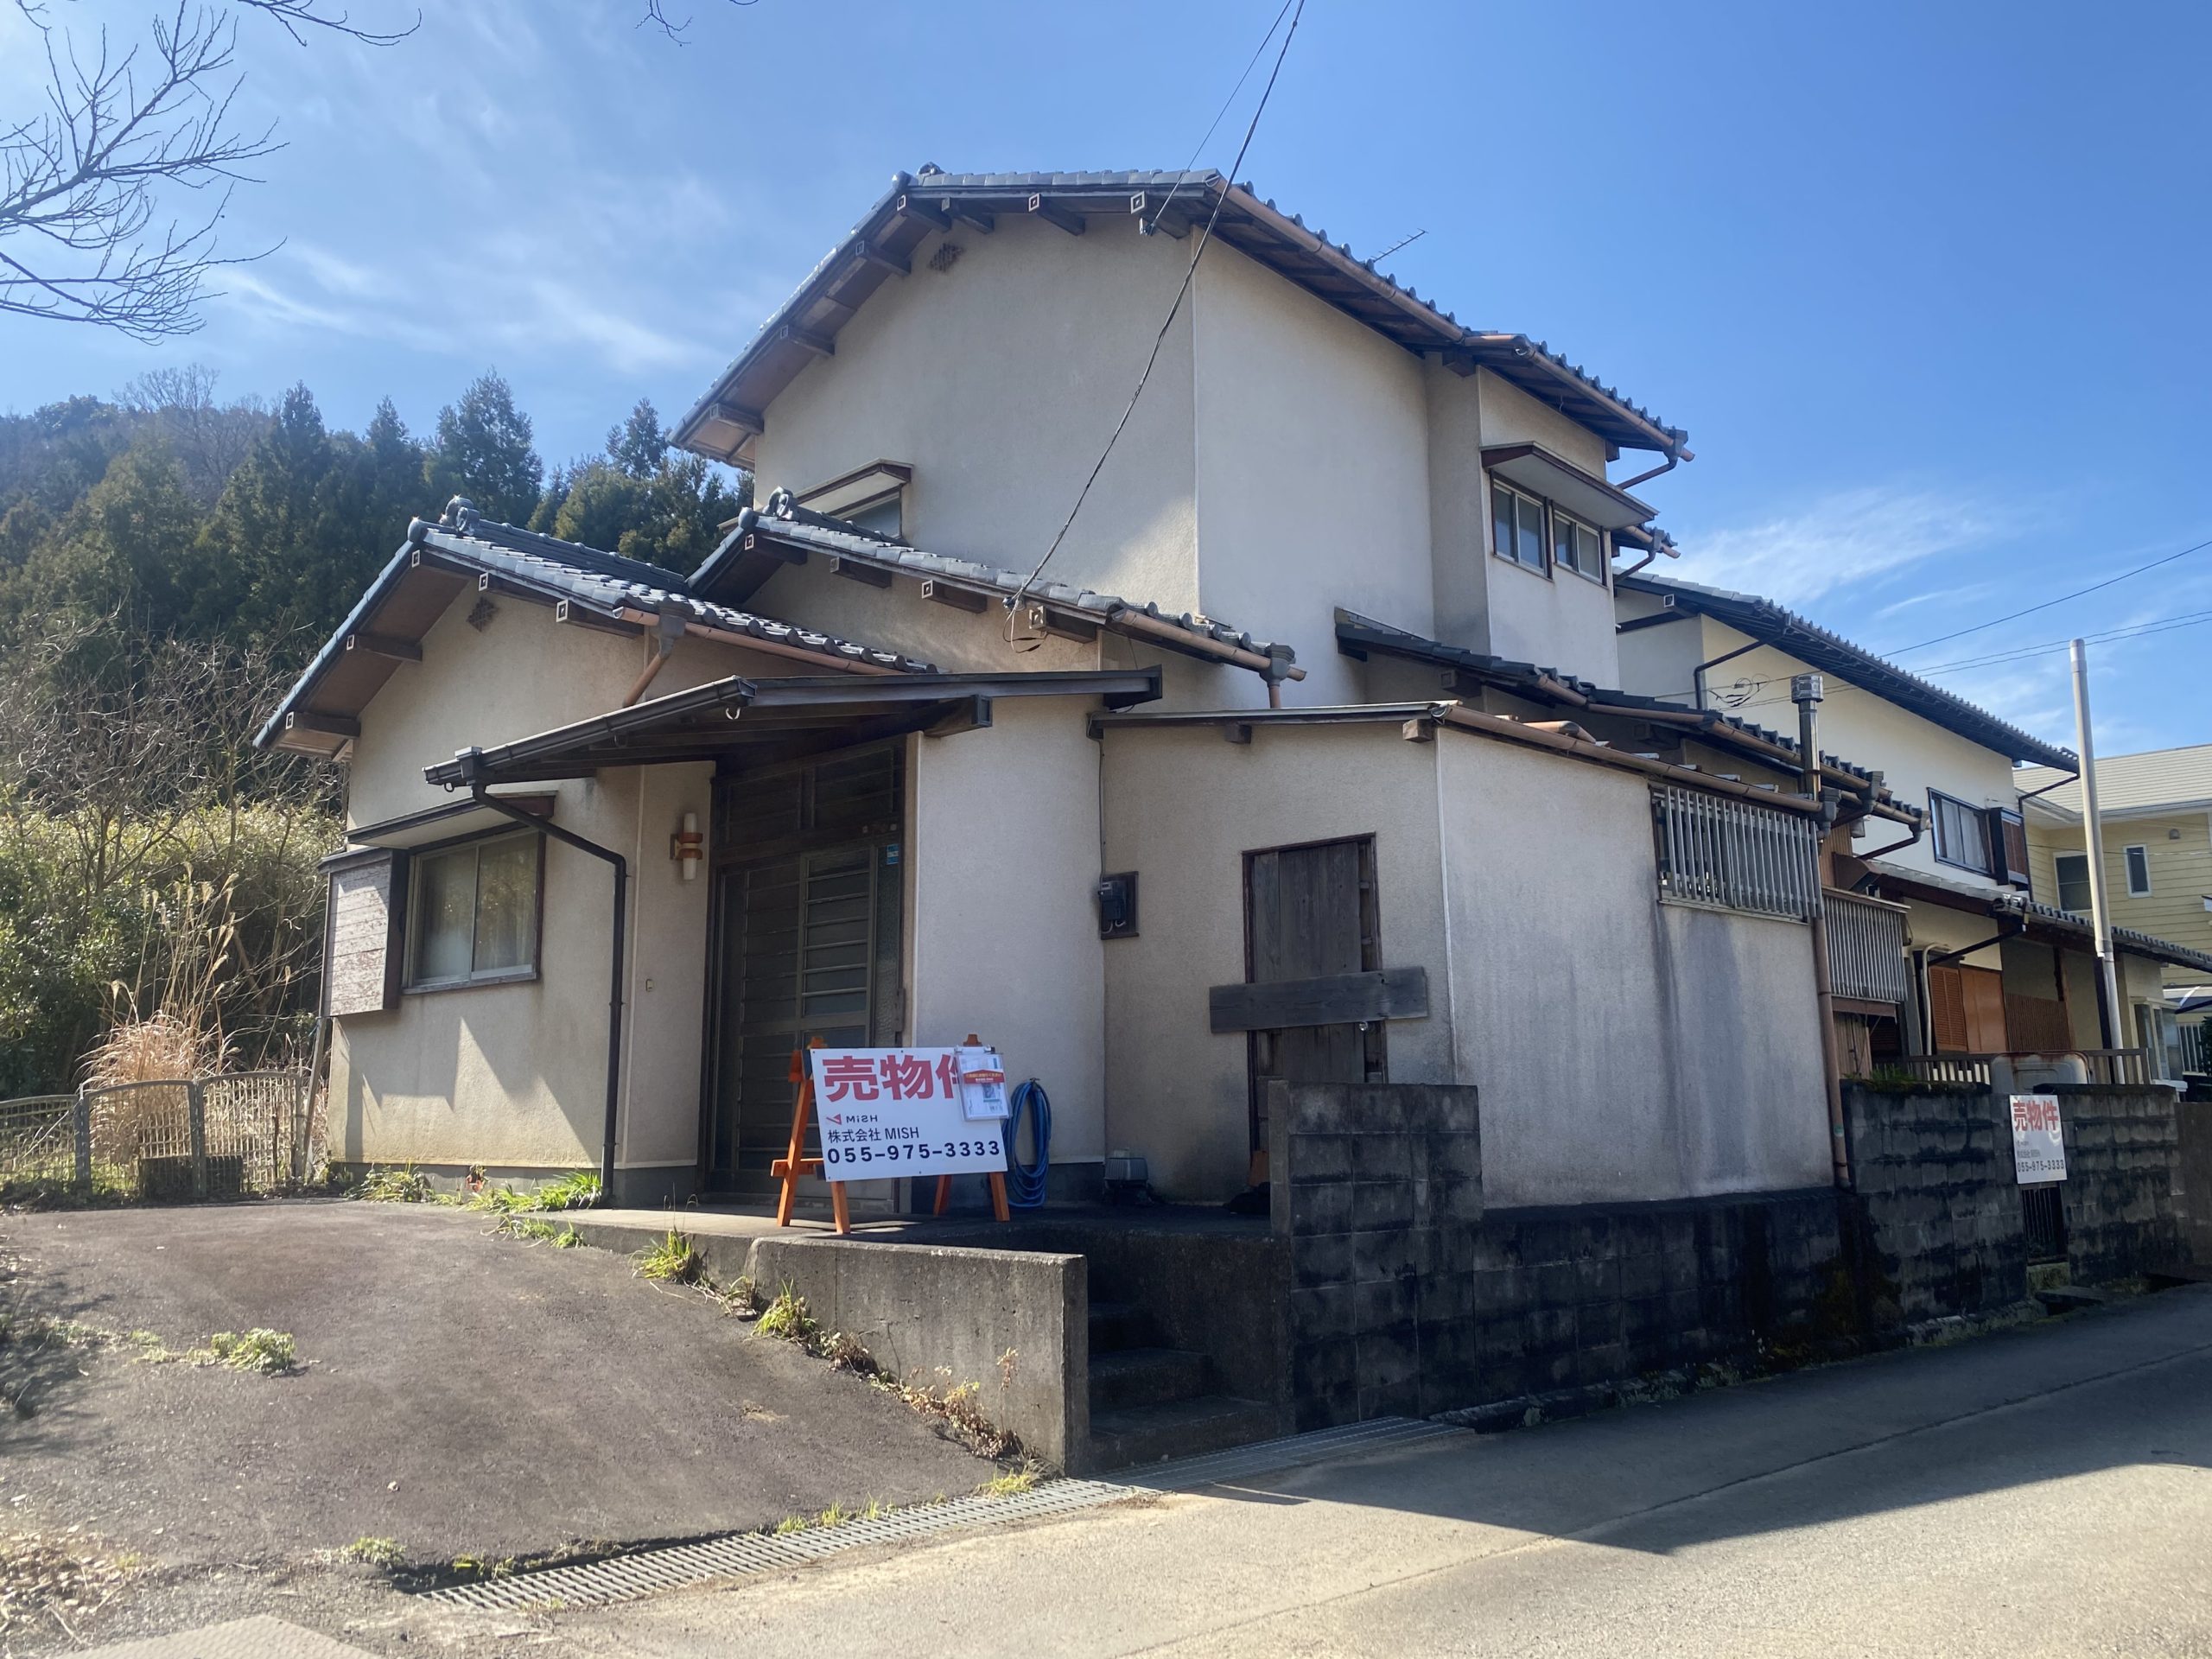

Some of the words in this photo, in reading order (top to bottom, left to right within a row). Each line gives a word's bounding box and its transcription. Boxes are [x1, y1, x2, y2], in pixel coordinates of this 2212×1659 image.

[2013, 1100, 2058, 1132] 売物件
[828, 1128, 882, 1143] 株式会社
[885, 1127, 919, 1140] MISH
[827, 1141, 1000, 1164] 055-975-3333
[2018, 1159, 2064, 1173] 055-975-3333
